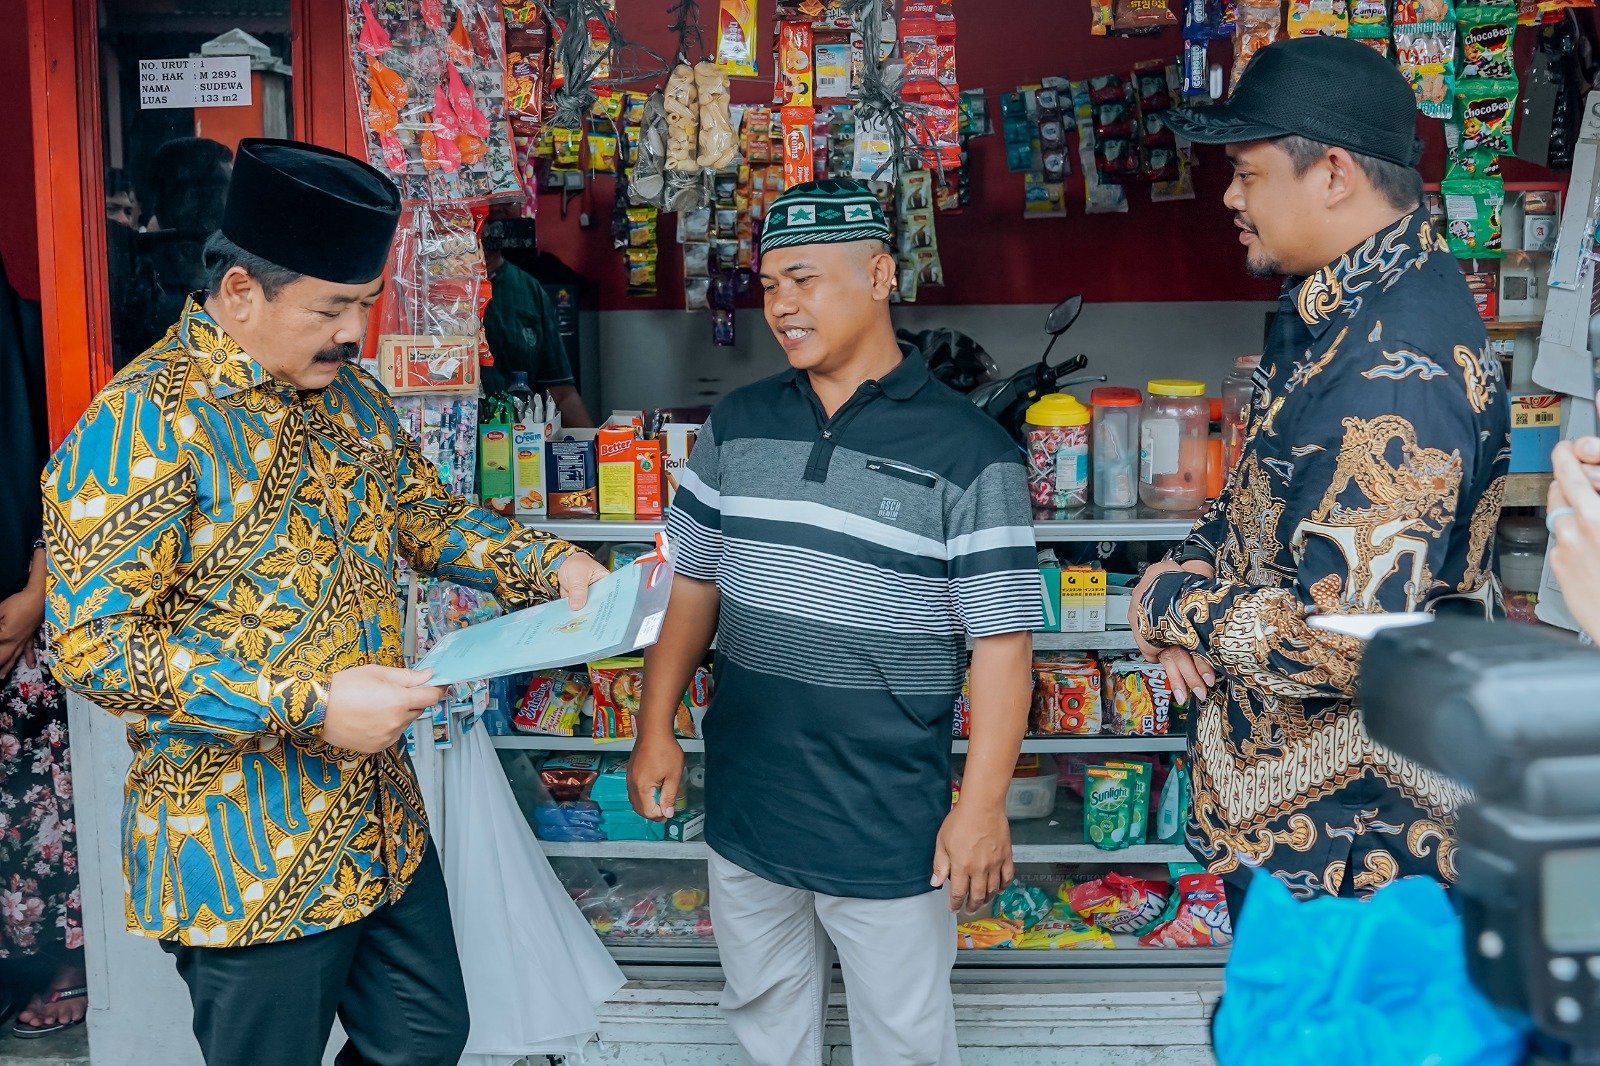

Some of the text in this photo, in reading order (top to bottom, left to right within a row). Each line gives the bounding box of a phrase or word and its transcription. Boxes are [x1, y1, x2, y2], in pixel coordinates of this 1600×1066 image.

[1464, 26, 1514, 45] ChocoBear
[141, 62, 158, 70] NO.
[162, 61, 188, 69] URUT
[200, 60, 205, 68] 1
[212, 71, 237, 79] 2893
[142, 85, 171, 93] NAMA
[200, 82, 243, 91] SUDEWA
[142, 96, 168, 104] LUAS
[222, 94, 238, 102] m2
[1463, 101, 1514, 119] ChocoBear
[791, 130, 800, 159] Roma
[515, 434, 542, 444] Cream
[601, 440, 631, 456] Better
[1091, 786, 1128, 806] Sunlight
